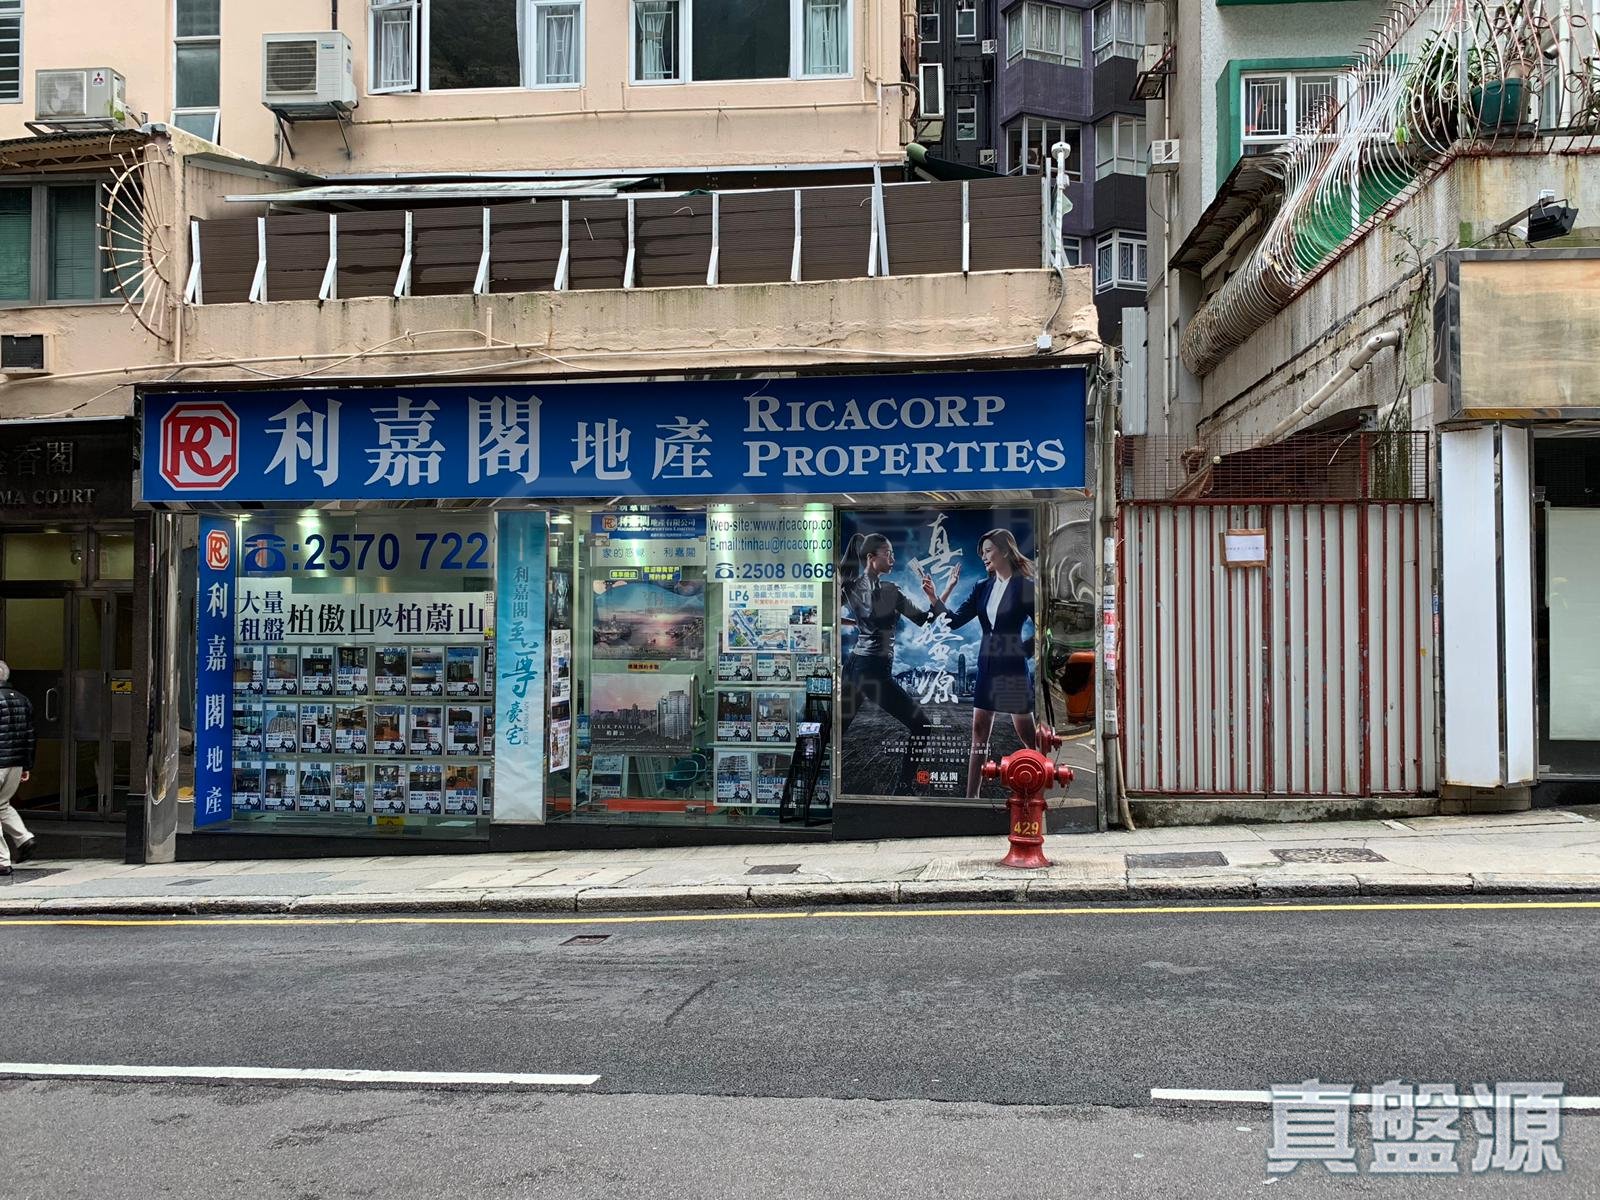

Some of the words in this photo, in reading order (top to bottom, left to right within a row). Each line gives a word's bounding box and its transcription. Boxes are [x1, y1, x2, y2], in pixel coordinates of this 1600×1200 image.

[743, 396, 1006, 432] RICACORP
[743, 438, 1066, 477] PROPERTIES
[31, 488, 97, 505] COURT
[416, 532, 495, 570] 722
[240, 591, 284, 614] 大量
[729, 590, 750, 602] LP6
[1014, 821, 1039, 836] 429
